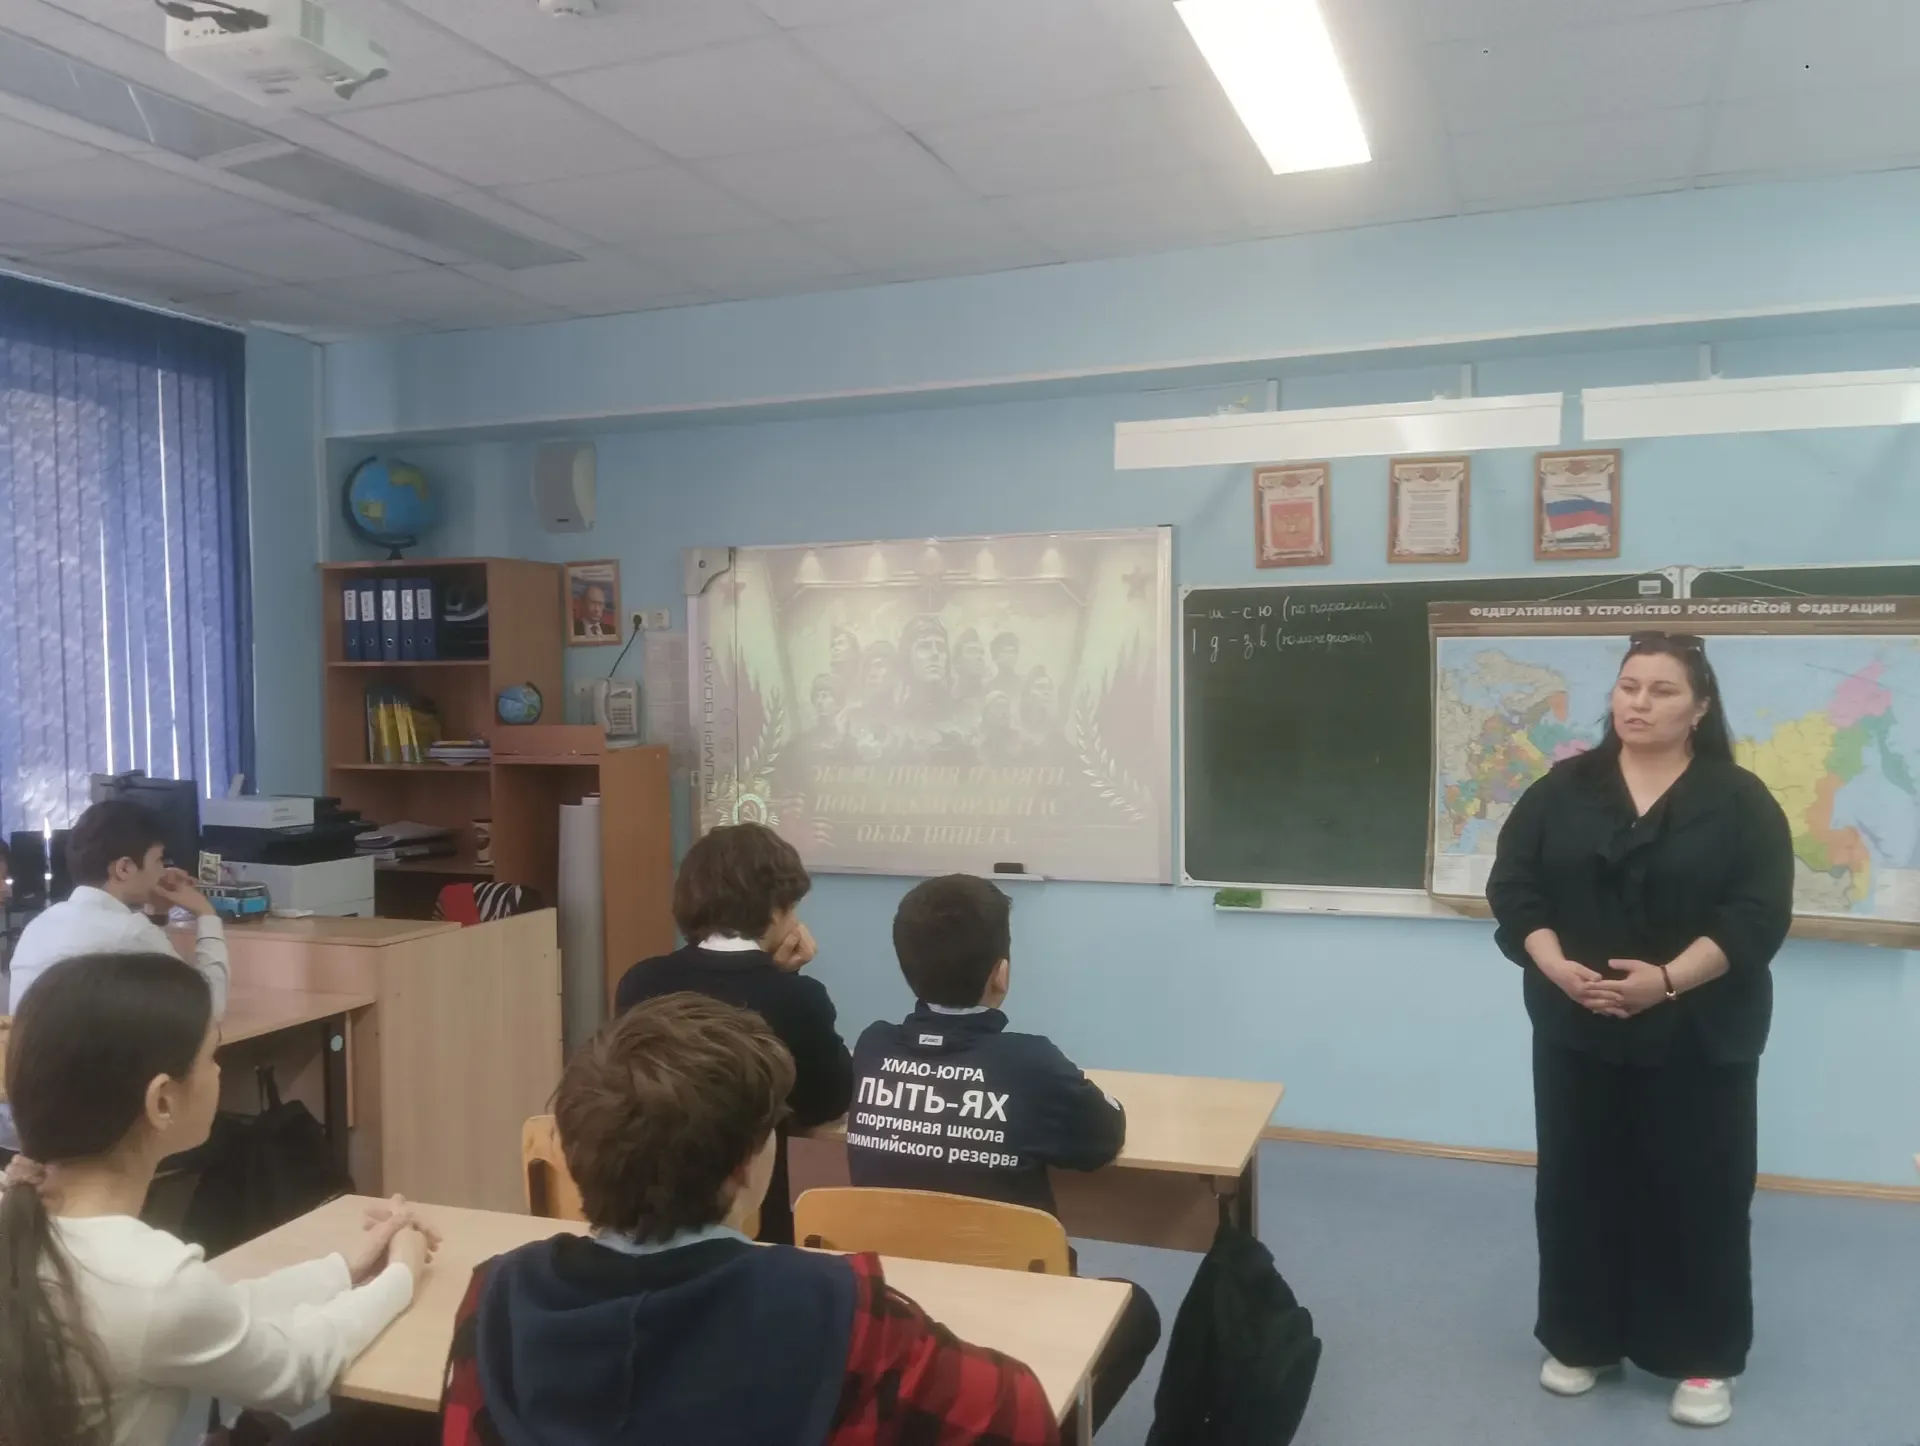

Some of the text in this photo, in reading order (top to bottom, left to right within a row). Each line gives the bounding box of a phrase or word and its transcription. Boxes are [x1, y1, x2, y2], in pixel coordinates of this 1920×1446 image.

[1469, 602, 1897, 618] ФЕДЕРАТИВНОЕ УСТРОЙСТВО РОССИЙСКОЙ ФЕДЕРАЦИИ
[703, 721, 715, 805] TRIUMPH
[880, 1057, 985, 1083] ХМАО-ЮГРА
[857, 1076, 1010, 1122] ПЫТЬ-ЯХ
[856, 1111, 1005, 1143] спортивная школа
[948, 1147, 1019, 1168] резерва
